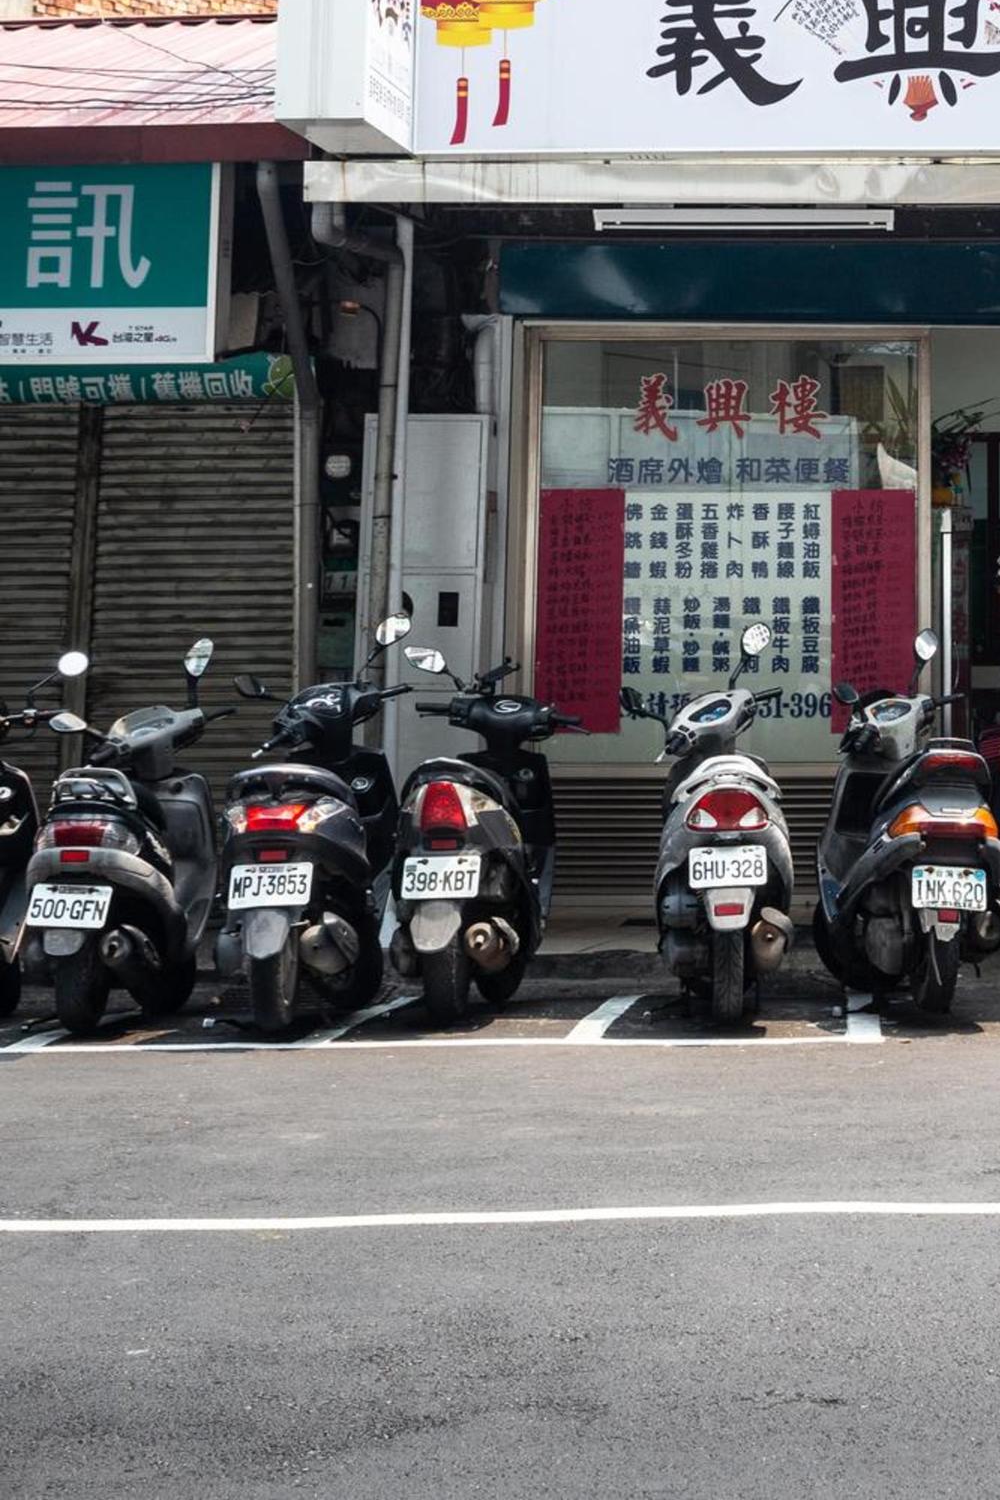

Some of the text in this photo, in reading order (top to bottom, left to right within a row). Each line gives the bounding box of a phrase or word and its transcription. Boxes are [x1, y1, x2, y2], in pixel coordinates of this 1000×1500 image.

[26, 181, 151, 289] 訊
[633, 372, 829, 442] 義興樓
[751, 503, 770, 579] 香酥鴨
[772, 596, 790, 673] 鐵板牛肉
[801, 596, 820, 674] 鐵板豆腐
